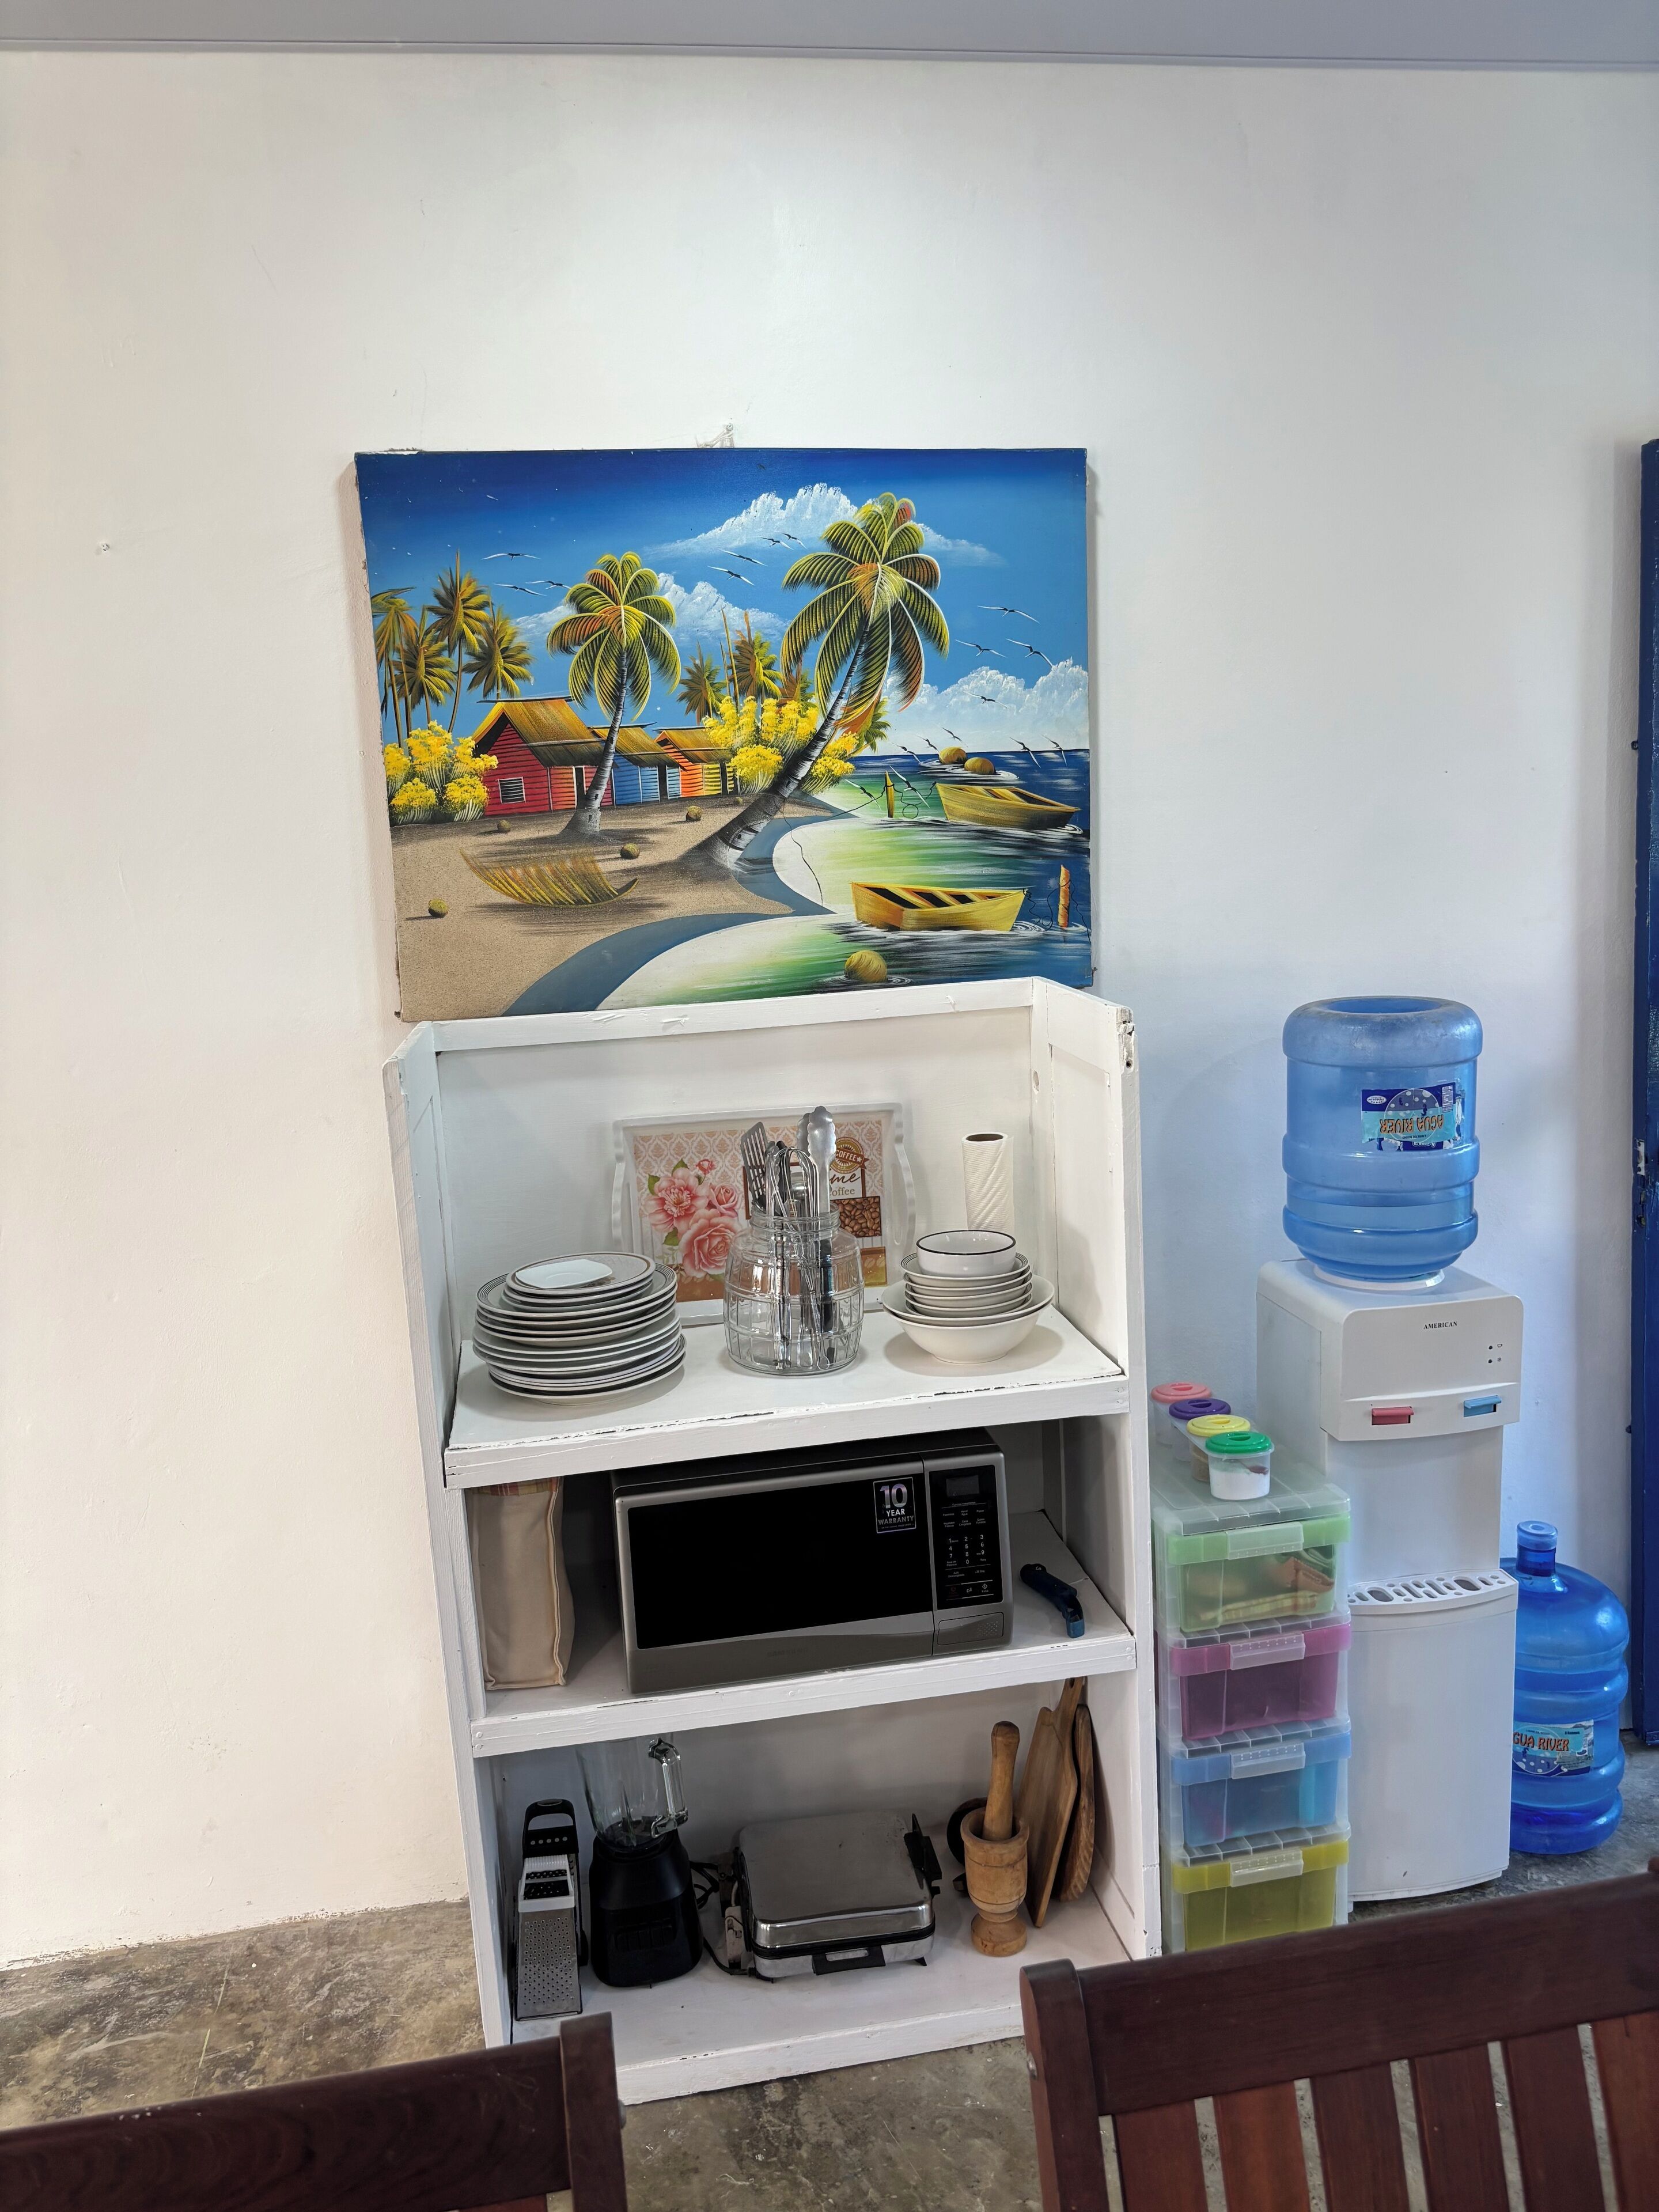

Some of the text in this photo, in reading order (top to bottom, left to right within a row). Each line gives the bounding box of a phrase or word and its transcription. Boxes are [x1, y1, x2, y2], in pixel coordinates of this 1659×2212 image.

[1379, 1114, 1444, 1134] AGUA RIVER
[835, 1150, 857, 1161] COFFEE
[830, 1173, 861, 1184] me
[830, 1187, 855, 1196] offee
[1423, 1321, 1457, 1330] AMERICAN
[880, 1483, 908, 1509] 10
[887, 1509, 905, 1517] YEAR
[878, 1516, 914, 1525] WARRANTY
[1513, 1732, 1569, 1751] GUA RIVER
